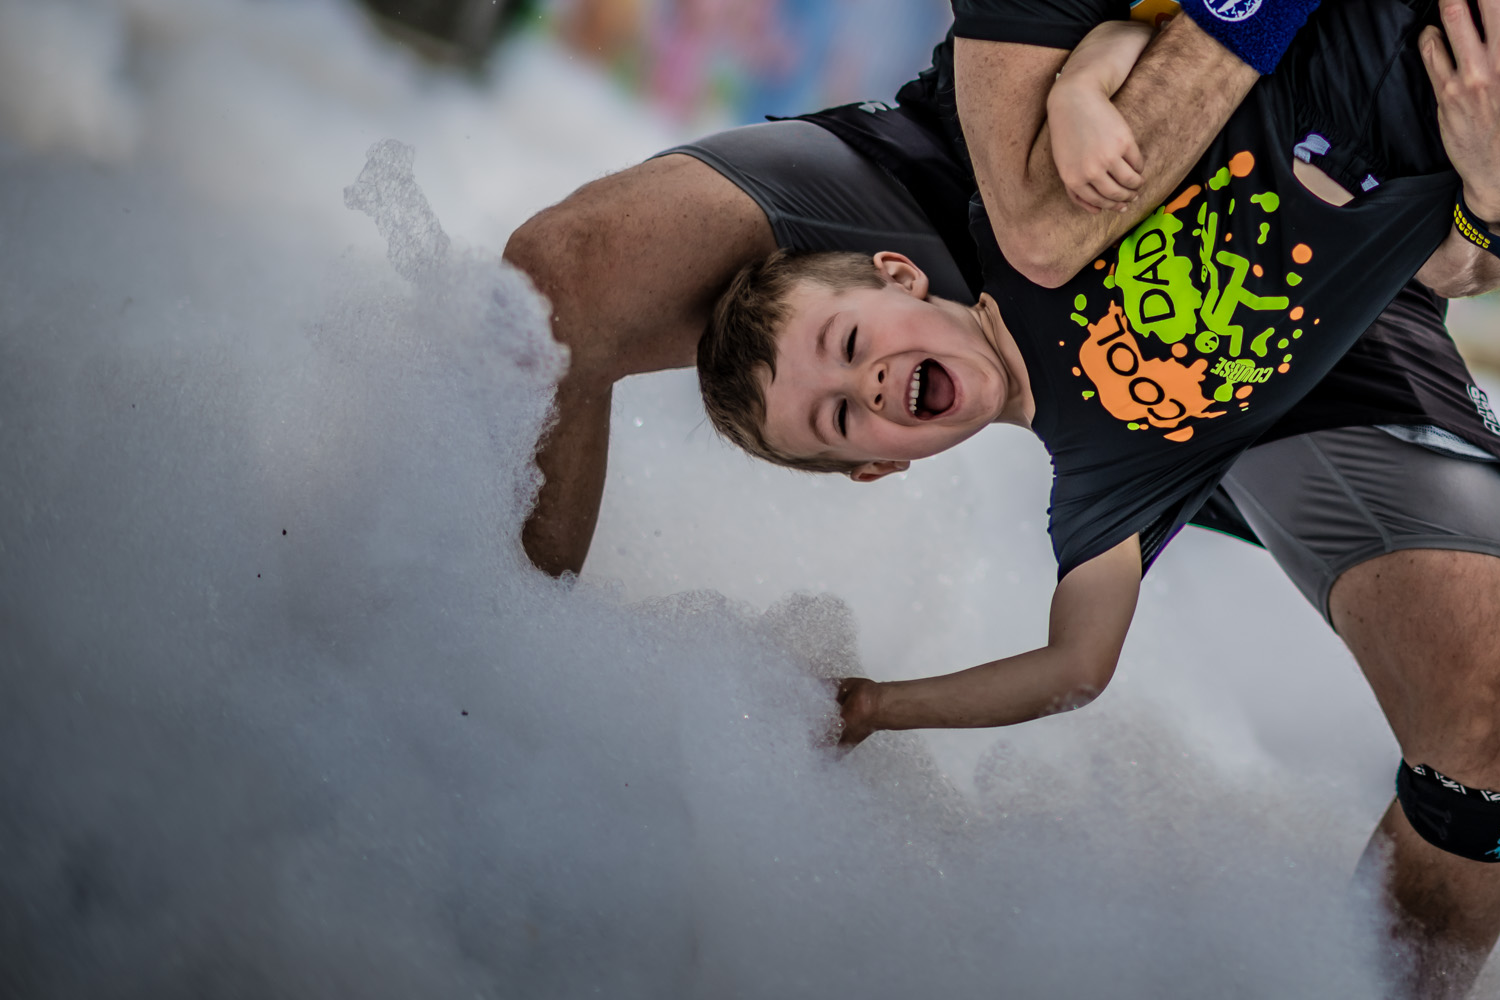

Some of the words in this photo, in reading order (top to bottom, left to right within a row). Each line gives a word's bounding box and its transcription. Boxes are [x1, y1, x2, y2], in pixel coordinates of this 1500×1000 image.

[1132, 228, 1177, 326] DAD
[1097, 313, 1187, 422] COOL
[1209, 356, 1275, 384] COURSE
